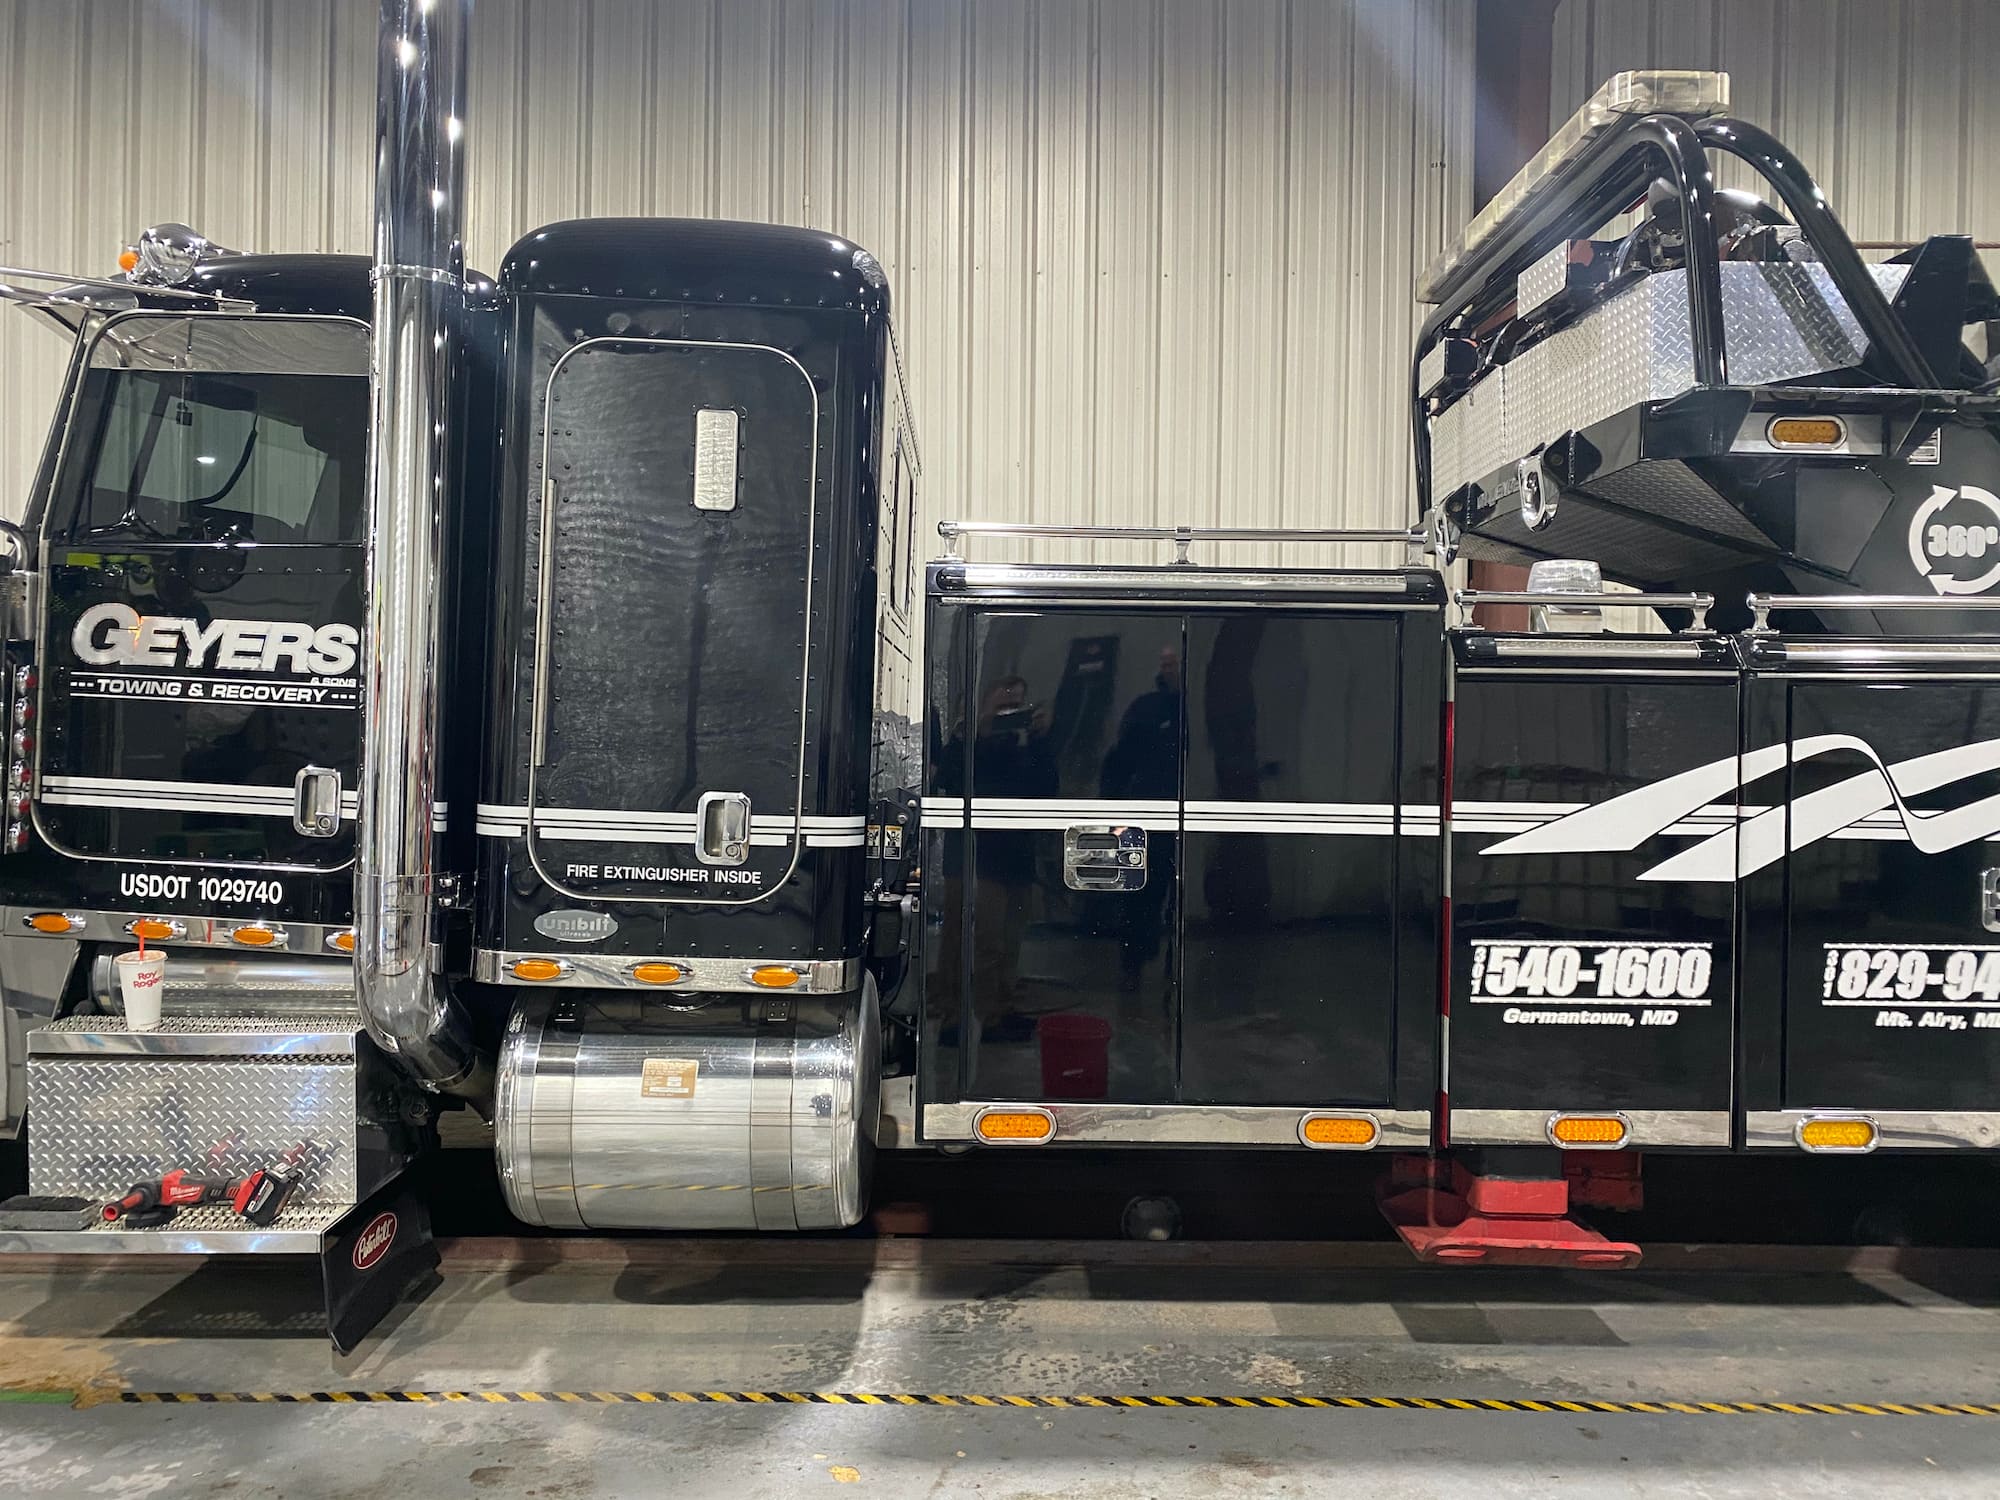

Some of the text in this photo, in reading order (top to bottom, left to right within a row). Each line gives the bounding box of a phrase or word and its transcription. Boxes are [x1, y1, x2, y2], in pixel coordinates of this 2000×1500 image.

[71, 602, 359, 675] GEYERS
[97, 679, 329, 702] TOWING & RECOVERY
[322, 677, 357, 686] SONS
[566, 864, 762, 884] FIRE EXTINGUISHER INSIDE
[121, 873, 283, 905] USDOT 1029740
[133, 976, 163, 988] Roger
[1471, 946, 1713, 999] 301 540-1600
[1823, 949, 1839, 998] 301
[1502, 1007, 1679, 1027] Germantown, MD
[1875, 1010, 1913, 1027] Mt.
[1917, 1011, 1967, 1031] Airy,
